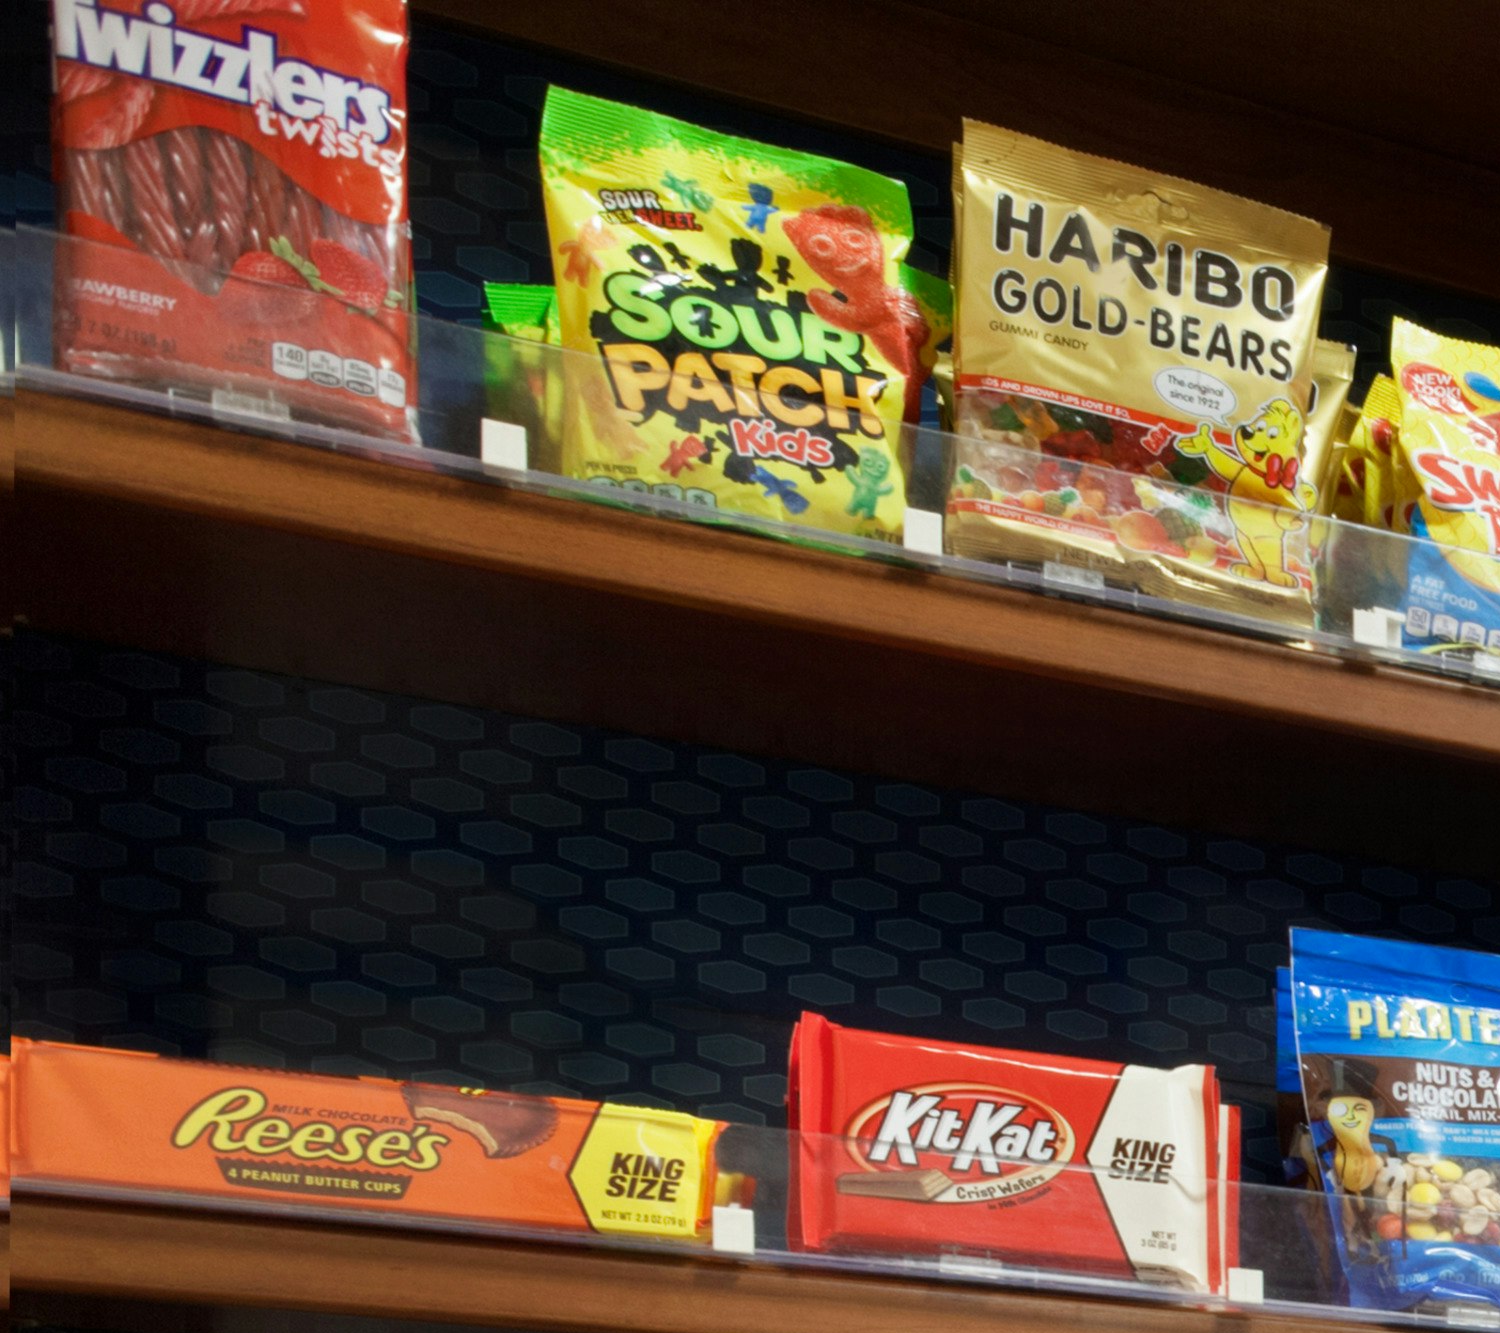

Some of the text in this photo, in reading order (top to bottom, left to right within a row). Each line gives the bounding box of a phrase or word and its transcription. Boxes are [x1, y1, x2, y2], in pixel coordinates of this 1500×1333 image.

[54, 0, 389, 143] Twizzlers
[256, 102, 402, 172] twists
[601, 189, 658, 210] SOUR
[994, 192, 1295, 322] HARIBO
[606, 272, 862, 373] SOUR
[989, 320, 1089, 352] GUMMI CANDY
[993, 268, 1294, 381] GOLD-BEARS
[604, 343, 884, 435] PATCH
[1167, 374, 1225, 398] The original
[1414, 372, 1452, 389] NEW
[1170, 389, 1221, 410] since 1922
[732, 419, 834, 466] Kids
[1410, 584, 1478, 612] FREE FOOD
[1415, 1062, 1473, 1089] NUTS
[174, 1086, 449, 1172] Reese's
[272, 1103, 408, 1127] MILK CHOCOLATE
[1112, 1137, 1176, 1162] KING
[611, 1152, 686, 1180] KING
[1108, 1158, 1172, 1184] SIZE
[242, 1168, 402, 1195] PEANUT BUTTER CUPS
[605, 1176, 679, 1203] SIZE
[956, 1172, 1046, 1201] Crisp Wafers
